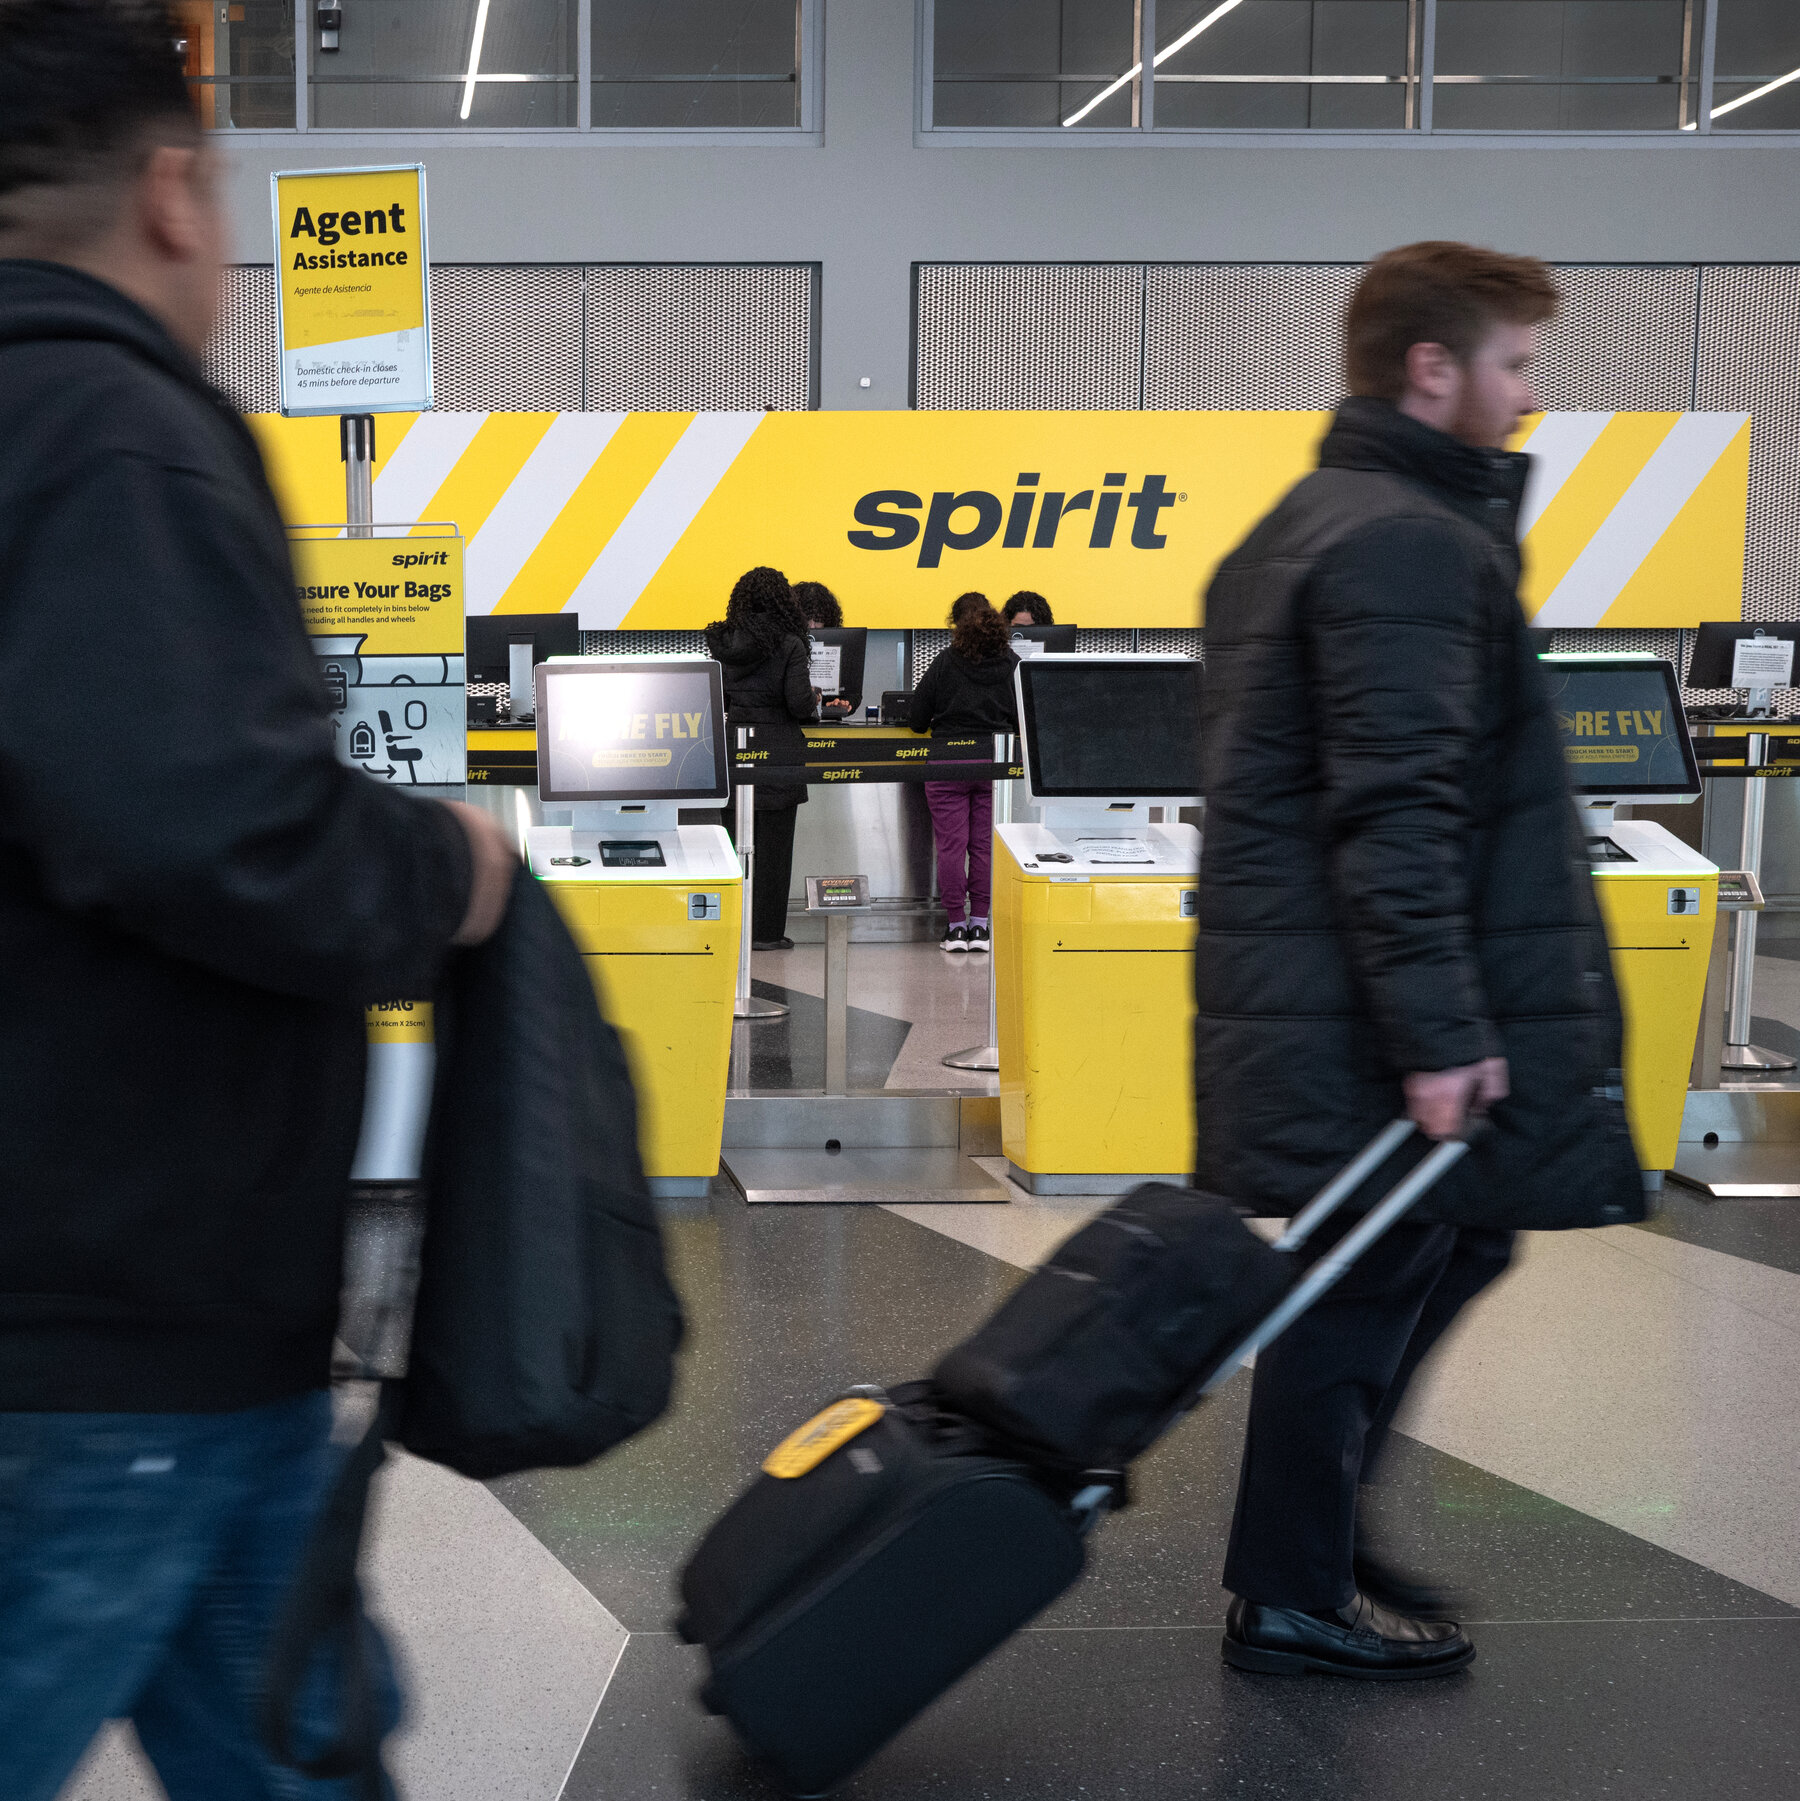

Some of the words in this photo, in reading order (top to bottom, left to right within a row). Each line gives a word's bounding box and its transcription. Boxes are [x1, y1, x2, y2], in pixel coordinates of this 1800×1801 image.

[290, 203, 406, 246] Agent
[293, 249, 408, 271] Assistance
[294, 286, 321, 297] Agente
[322, 285, 333, 294] de
[333, 283, 372, 293] Asistencia
[297, 366, 335, 376] Domestic
[336, 364, 371, 374] check-in
[372, 363, 398, 373] closes
[297, 379, 308, 388] 45
[309, 378, 329, 387] mins
[330, 377, 357, 387] before
[358, 376, 400, 388] departure
[392, 551, 448, 569] spirit
[297, 585, 350, 600] asure
[353, 581, 400, 599] Your
[404, 581, 452, 602] Bags
[306, 606, 324, 614] need
[334, 605, 343, 613] fit
[344, 605, 382, 614] completely
[383, 604, 391, 612] in
[392, 604, 407, 612] bins
[408, 604, 430, 612] below
[304, 616, 335, 625] ncluding
[336, 616, 346, 624] all
[390, 615, 416, 623] wheels
[654, 712, 703, 739] FLY
[1575, 710, 1610, 736] RE
[1616, 710, 1662, 735] FLY
[736, 751, 769, 761] spirit
[896, 748, 929, 758] spirit
[468, 770, 488, 780] irit
[822, 769, 861, 781] spirit
[1754, 767, 1792, 777] spirit
[378, 999, 414, 1011] BAG
[405, 1020, 426, 1028] 25cm)
